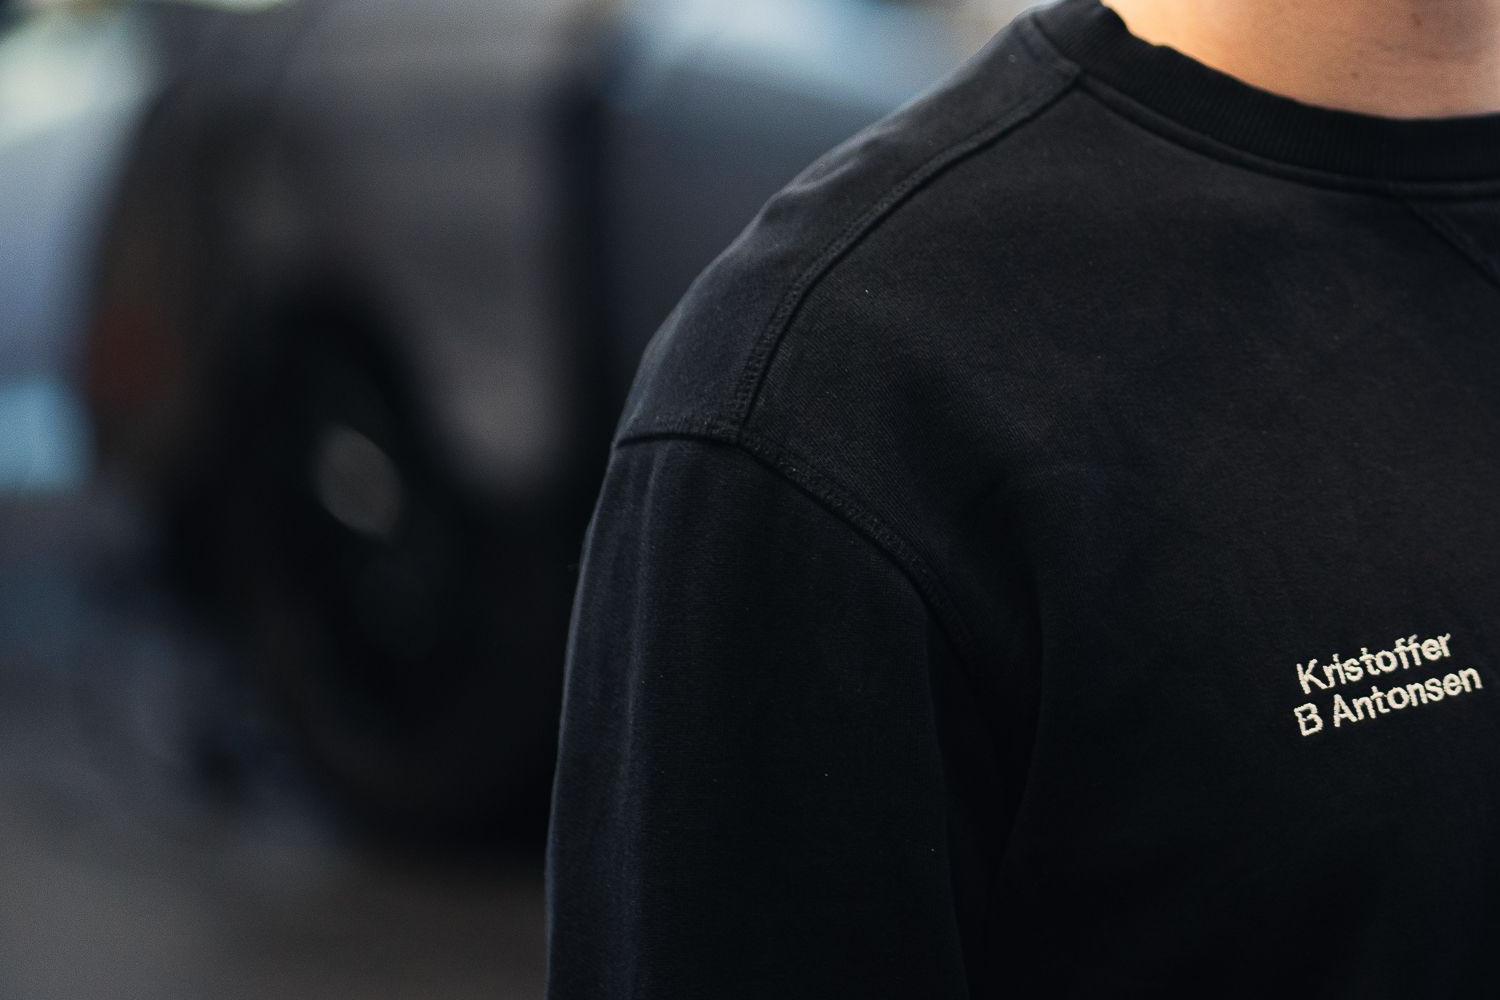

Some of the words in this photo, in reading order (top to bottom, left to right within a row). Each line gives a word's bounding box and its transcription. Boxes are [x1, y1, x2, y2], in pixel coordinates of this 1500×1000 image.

[1296, 633, 1451, 694] Kristoffer
[1294, 703, 1323, 736] B
[1333, 668, 1483, 727] Antonsen
